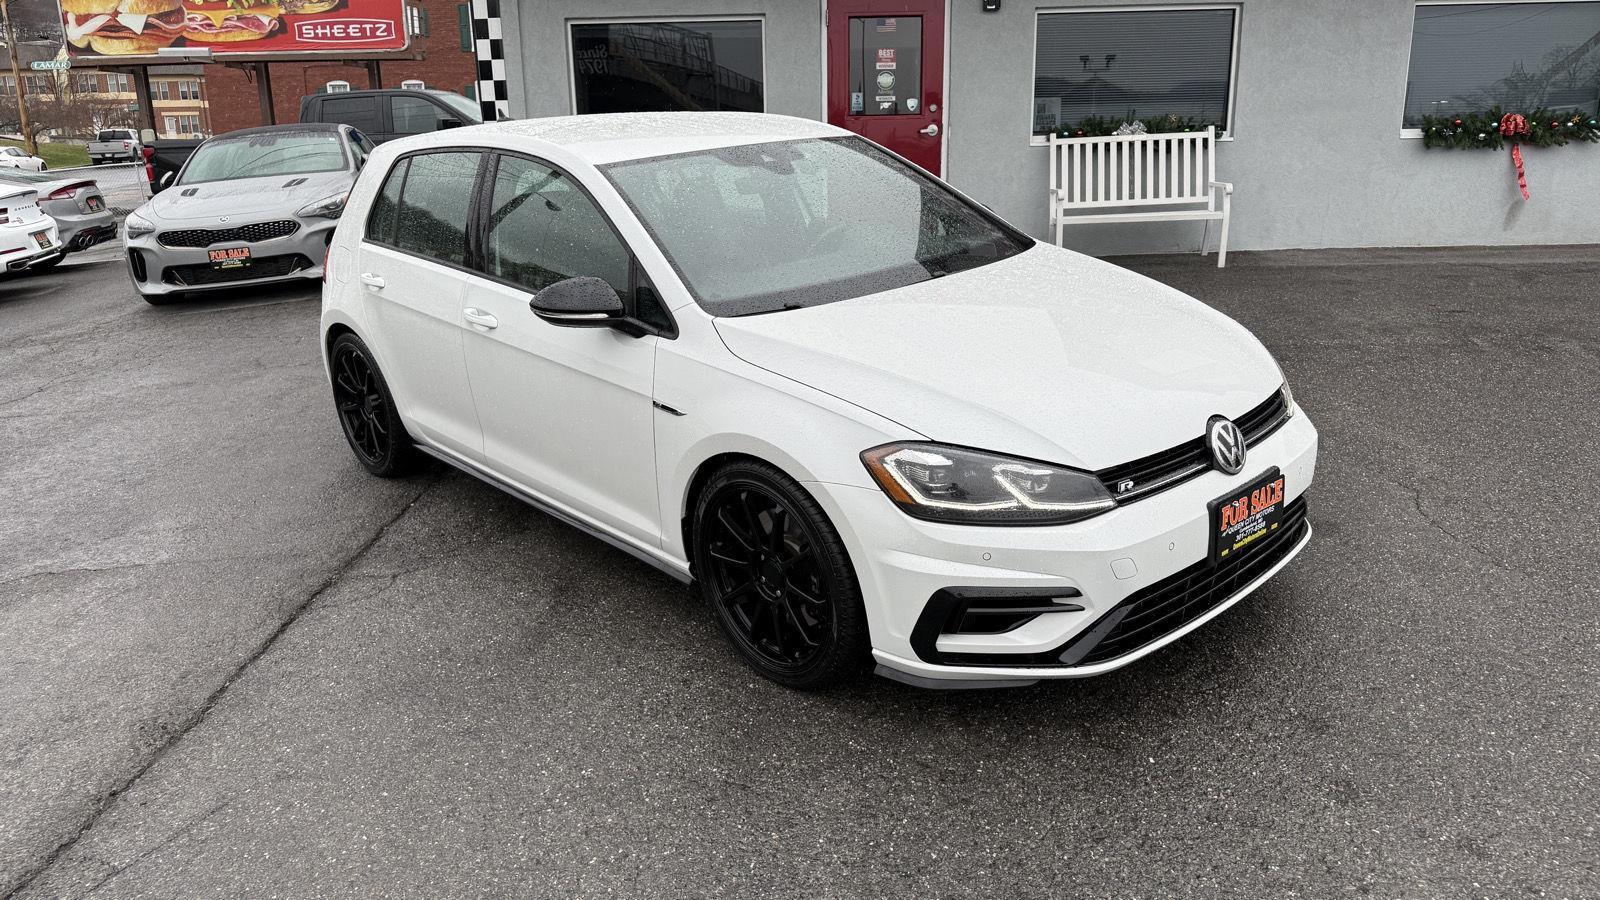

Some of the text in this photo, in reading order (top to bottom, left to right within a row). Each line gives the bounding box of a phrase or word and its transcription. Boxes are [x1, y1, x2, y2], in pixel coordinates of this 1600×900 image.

[302, 23, 388, 38] SHEETZ
[878, 49, 895, 57] BEST
[34, 61, 67, 69] LAMAR
[209, 247, 250, 260] FOR SALE
[1118, 479, 1134, 493] R
[1221, 478, 1283, 531] FOR SALE
[1255, 505, 1275, 519] MOTORS
